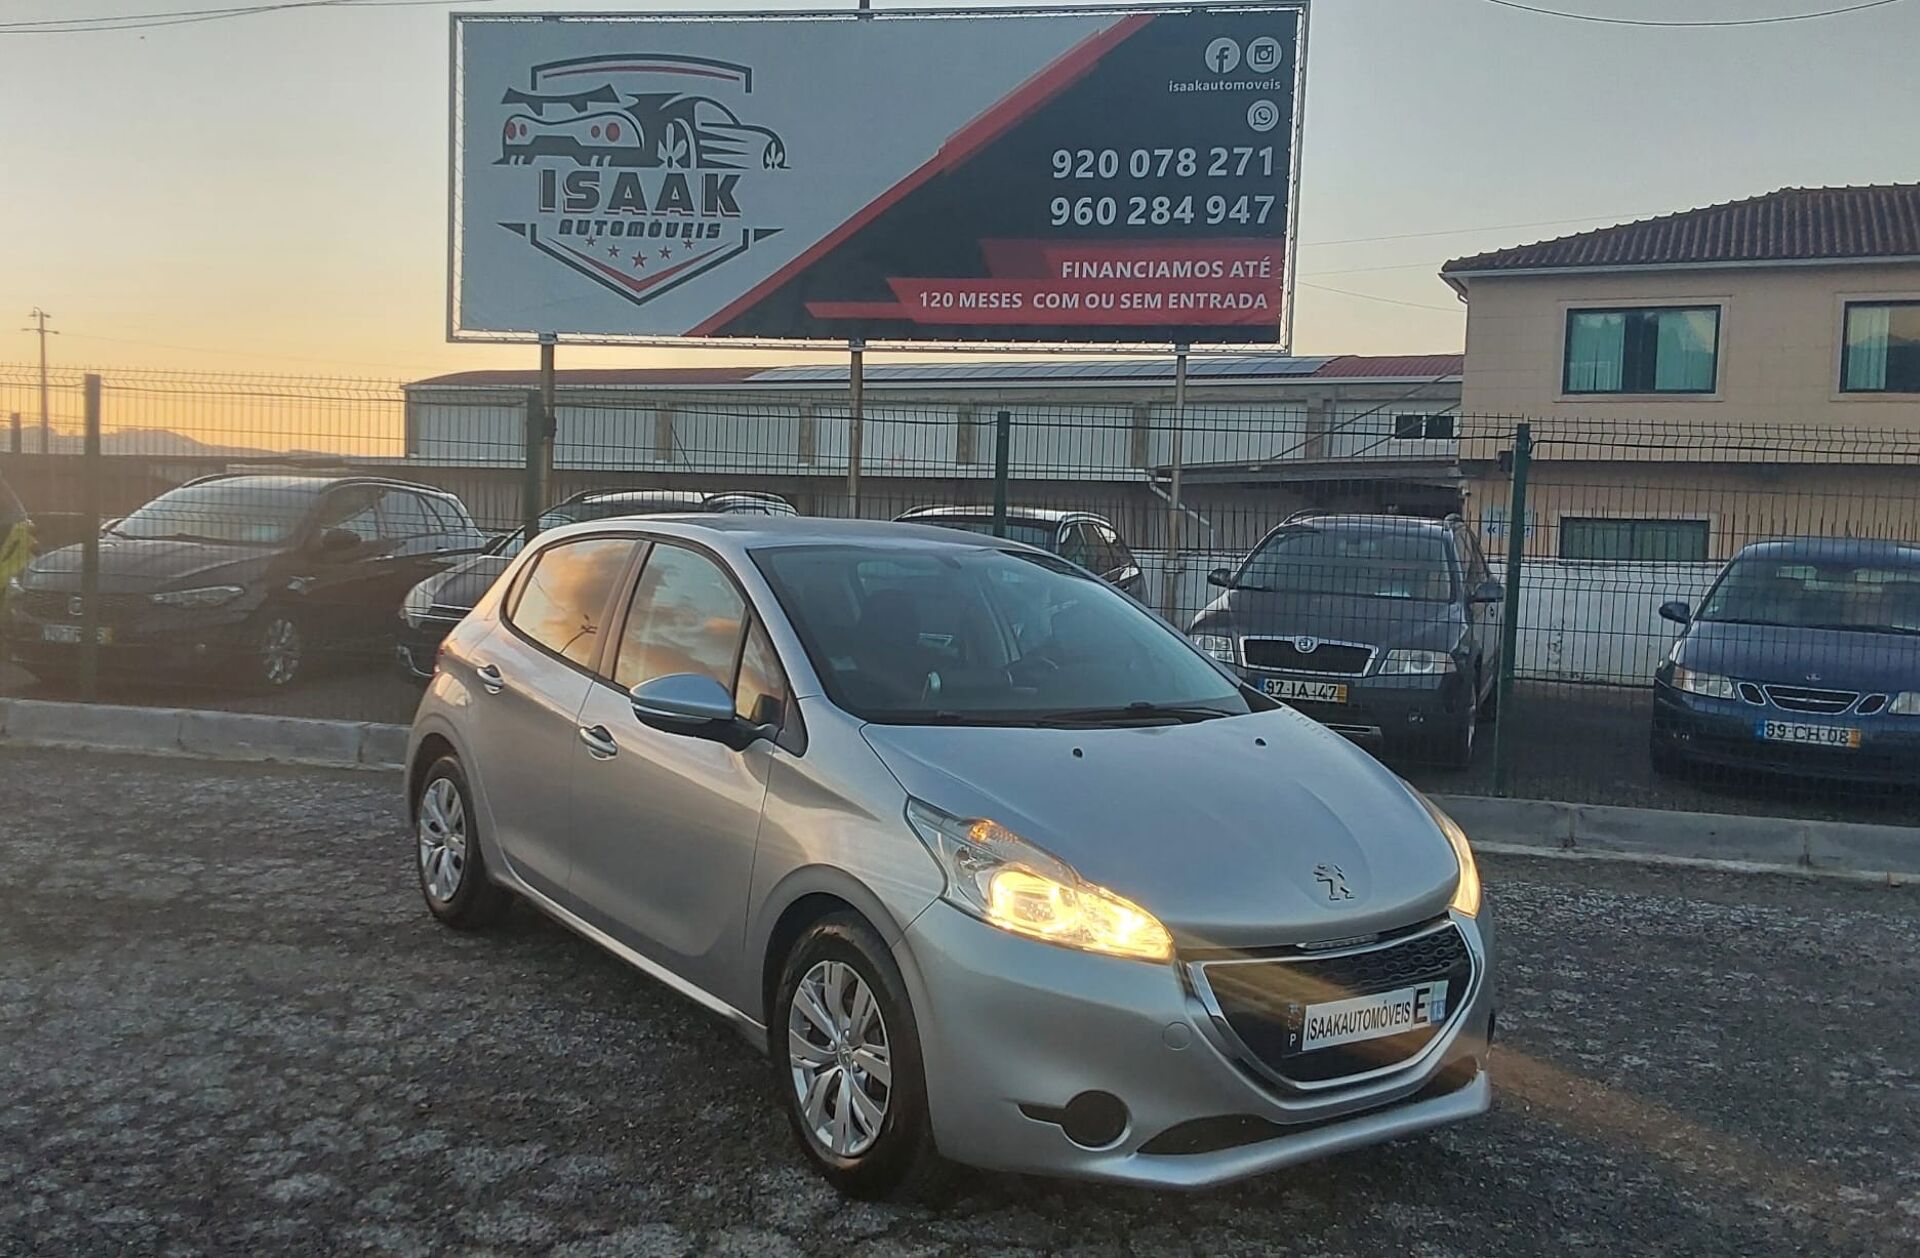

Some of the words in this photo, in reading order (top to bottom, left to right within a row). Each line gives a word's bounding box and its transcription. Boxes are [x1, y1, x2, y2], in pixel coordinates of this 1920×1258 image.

[1168, 78, 1281, 93] isaakautomoveis
[1052, 149, 1119, 179] 920
[1129, 148, 1197, 177] 078
[1207, 146, 1275, 176] 271
[539, 169, 742, 218] ISAAK
[1050, 197, 1117, 226] 960
[1127, 196, 1195, 225] 284
[1205, 195, 1275, 224] 947
[1061, 261, 1224, 279] FINANCIAMOS
[1229, 256, 1271, 278] ATÉ
[919, 291, 954, 308] 120
[958, 292, 1023, 308] MESES
[1033, 293, 1079, 309] COM
[1085, 293, 1115, 309] OU
[1119, 293, 1163, 309] SEM
[1167, 293, 1268, 309] ENTRADA
[1305, 1001, 1411, 1040] ISAAKAUTOMÓVEIS
